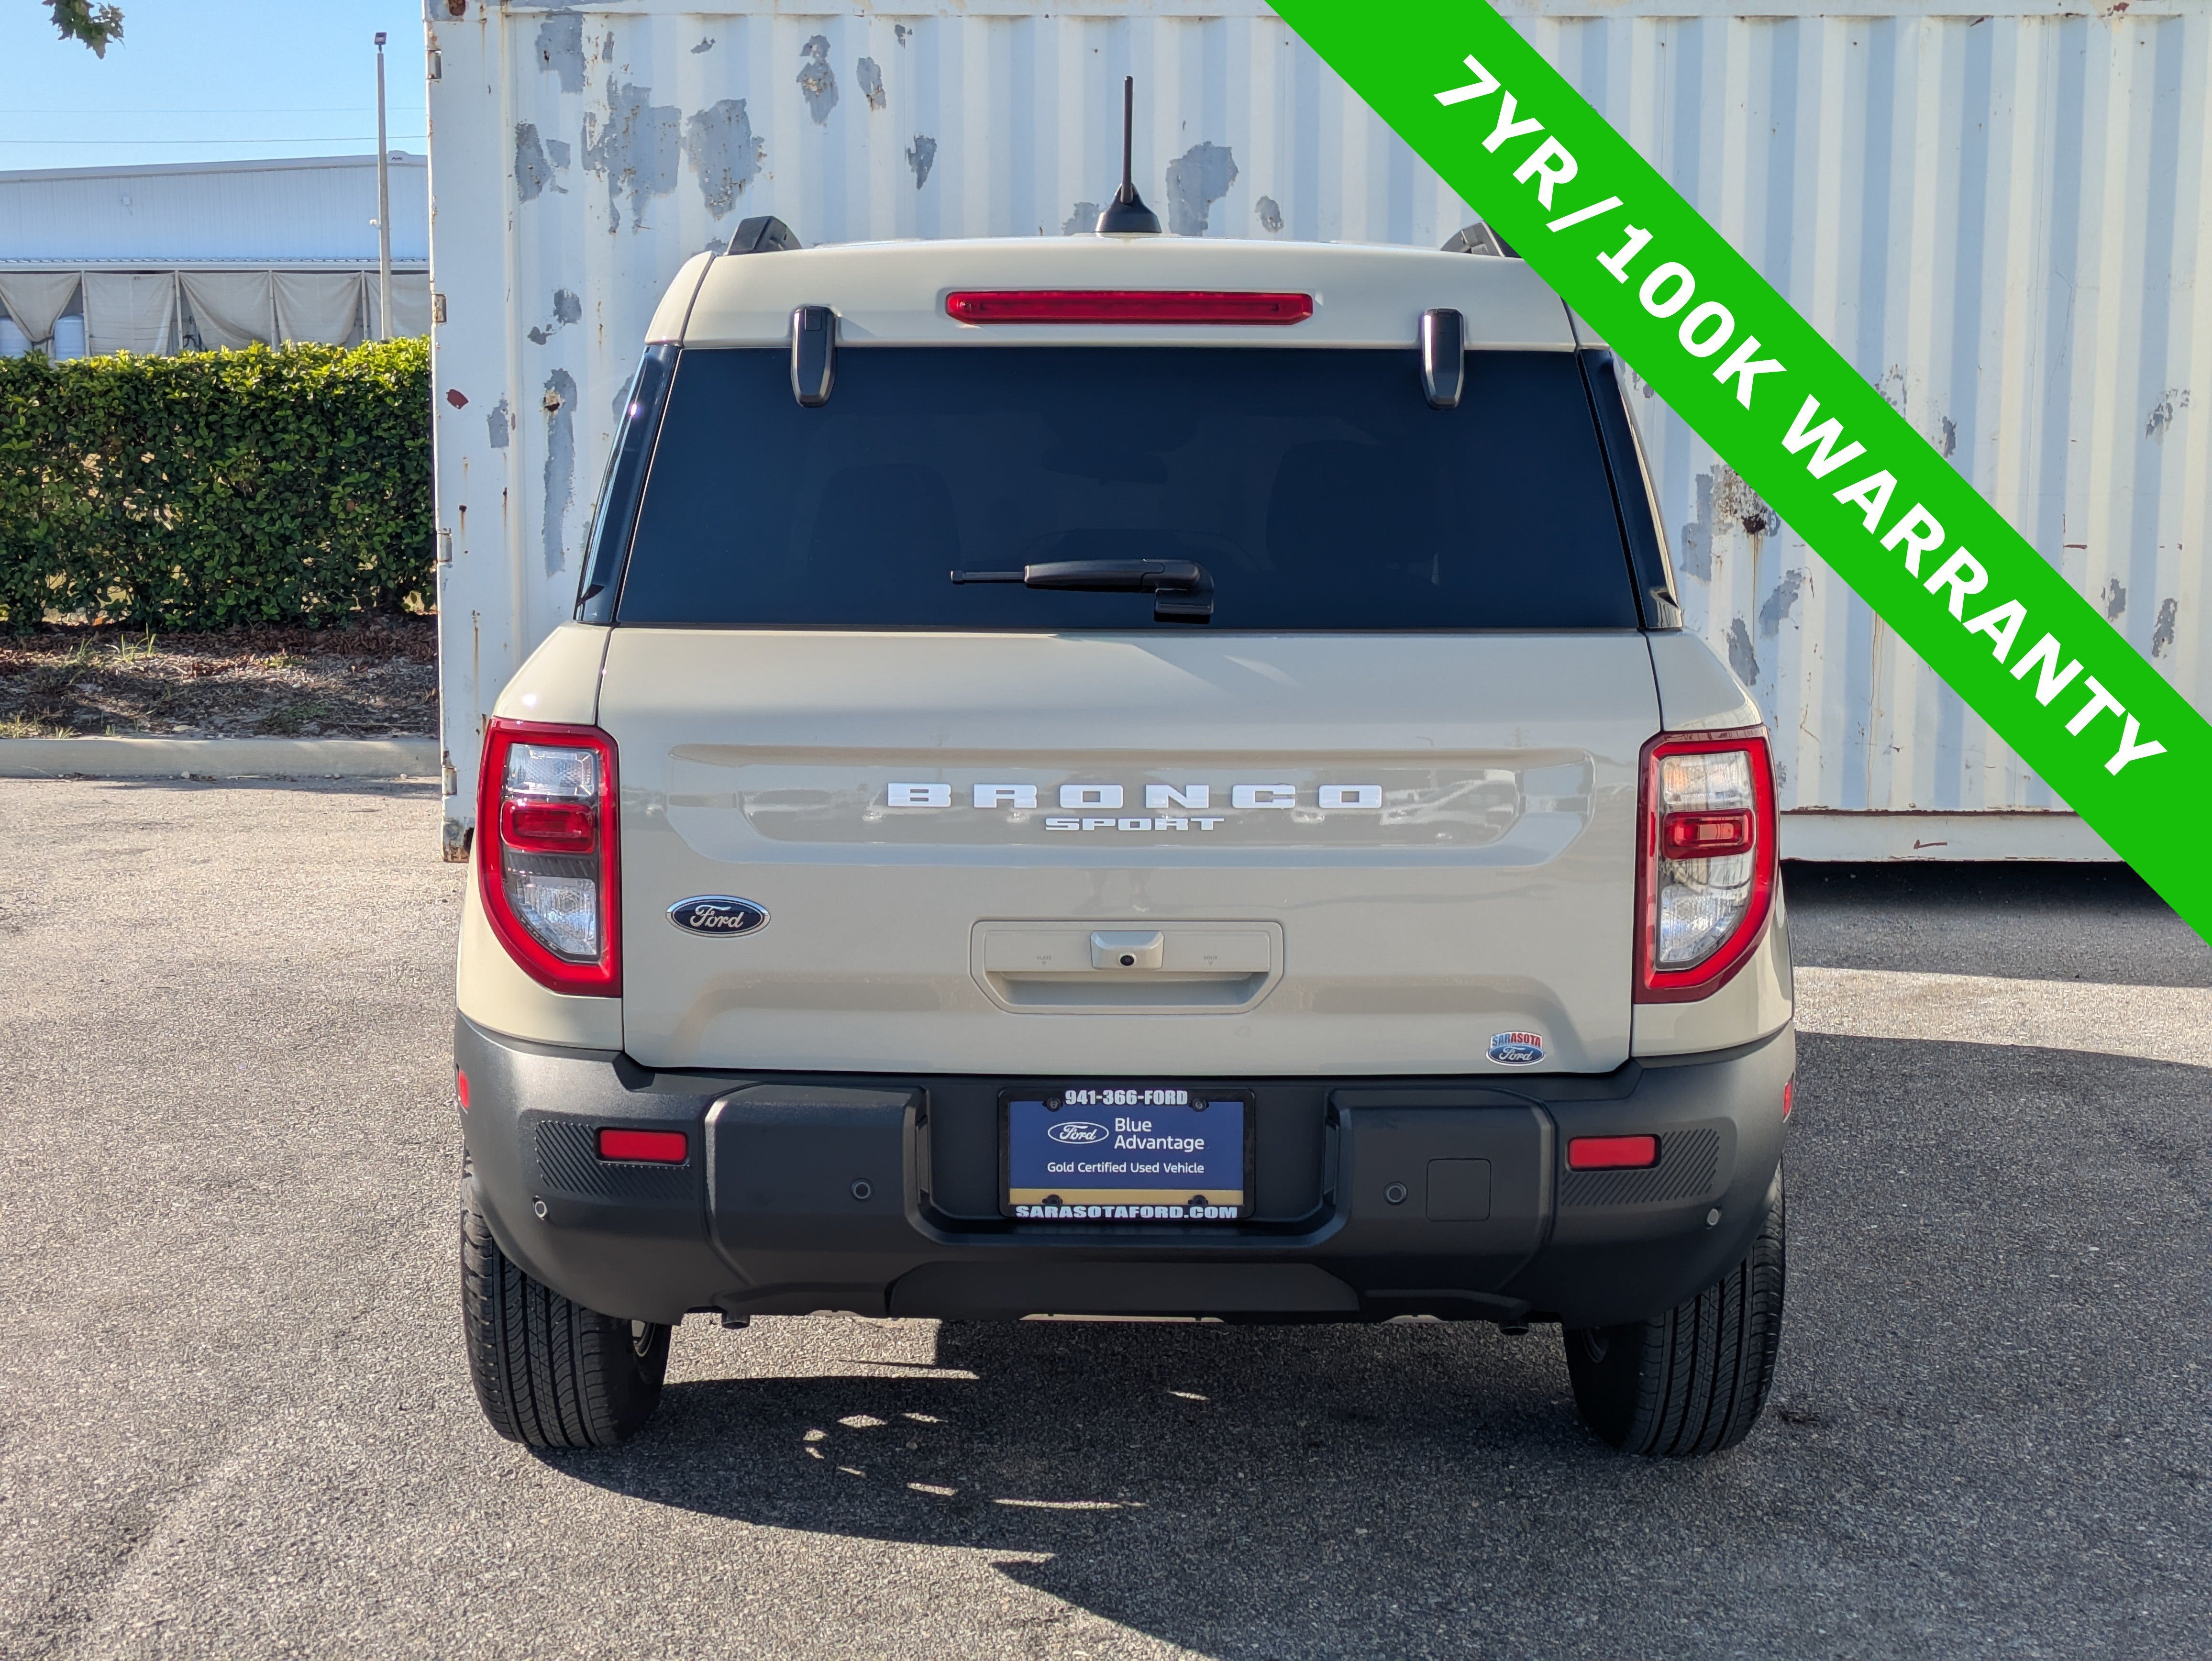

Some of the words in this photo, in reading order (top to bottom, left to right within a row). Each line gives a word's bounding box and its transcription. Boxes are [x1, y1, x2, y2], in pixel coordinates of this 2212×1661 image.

[887, 782, 1383, 809] BRONCO
[1045, 817, 1225, 831] SPORT
[690, 904, 745, 928] Ford
[1492, 1033, 1541, 1048] SARASOTA
[1499, 1046, 1534, 1061] Ford
[1065, 1090, 1188, 1105] 941-366-FORD
[1115, 1117, 1152, 1132] Blue
[1059, 1124, 1097, 1141] Ford
[1114, 1134, 1205, 1152] Advantage
[1047, 1162, 1074, 1173] Gold
[1078, 1162, 1127, 1173] Certified
[1130, 1162, 1160, 1173] Used
[1163, 1162, 1205, 1174] Vehicle
[1016, 1206, 1238, 1218] SARASOTAFORD.COM
